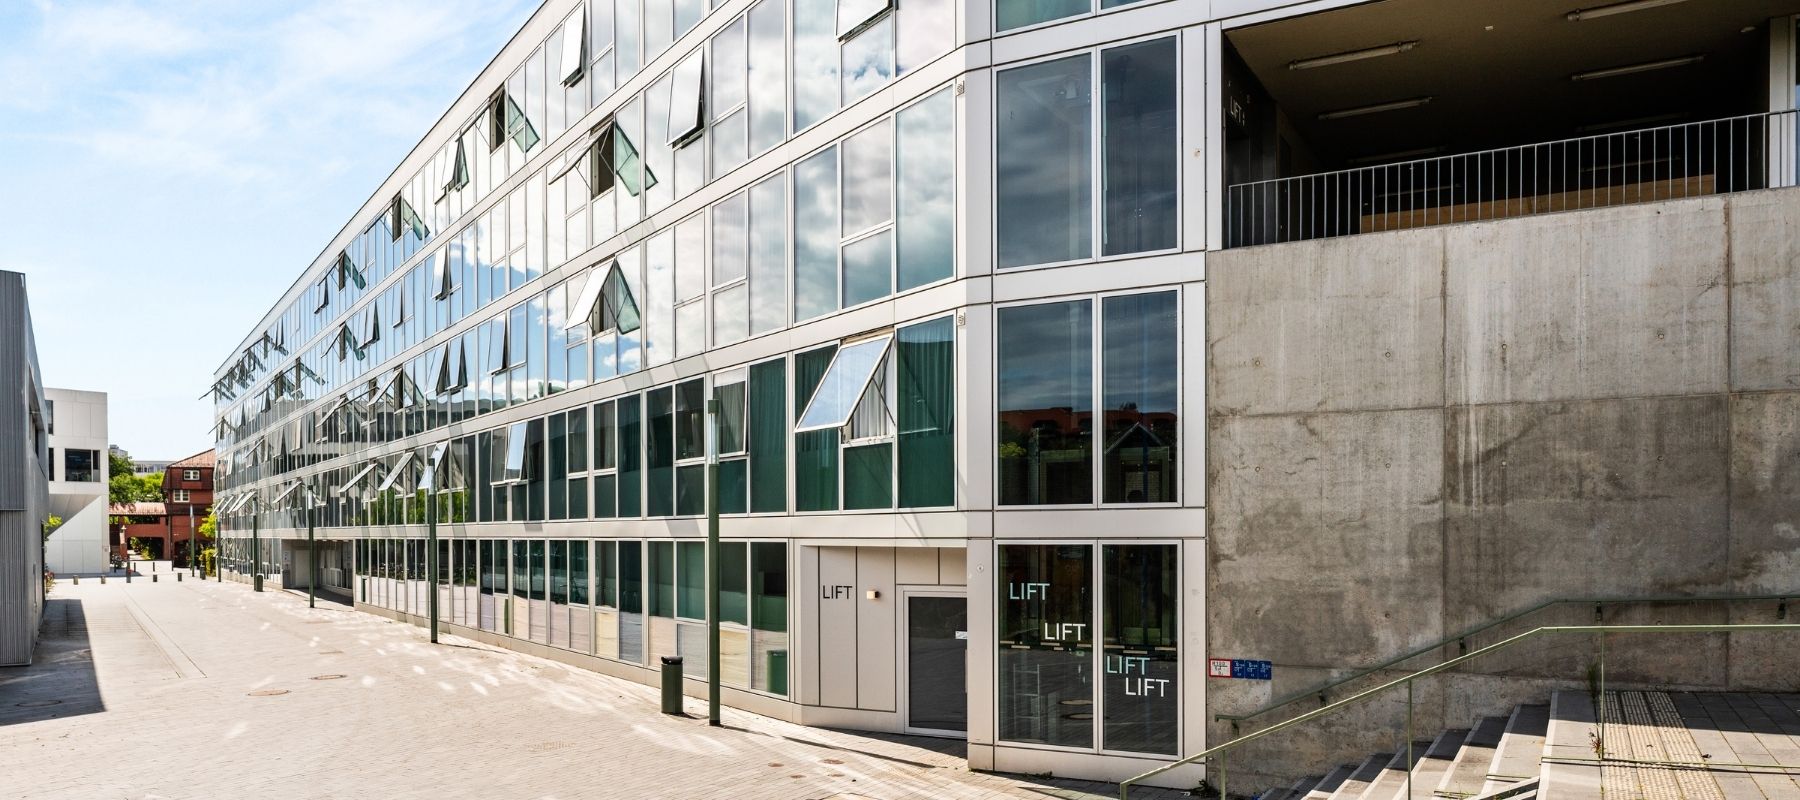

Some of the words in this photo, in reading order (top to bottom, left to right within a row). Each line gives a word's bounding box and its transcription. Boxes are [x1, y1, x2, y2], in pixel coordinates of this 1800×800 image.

[823, 585, 853, 599] LIFT
[1009, 582, 1051, 601] LIFT
[1044, 623, 1086, 641] LIFT
[1106, 655, 1151, 674] LIFT
[1125, 677, 1169, 697] LIFT
